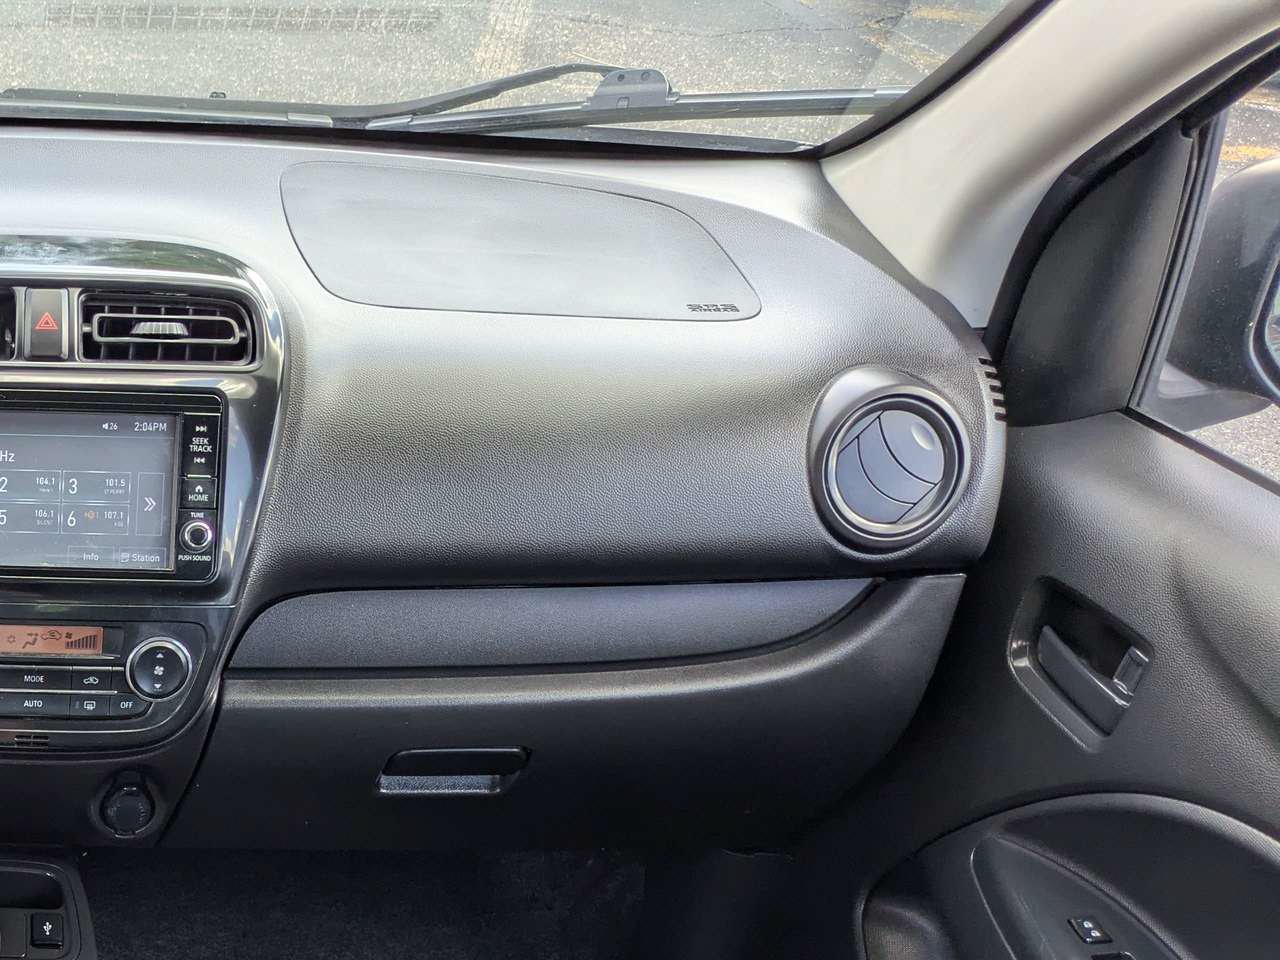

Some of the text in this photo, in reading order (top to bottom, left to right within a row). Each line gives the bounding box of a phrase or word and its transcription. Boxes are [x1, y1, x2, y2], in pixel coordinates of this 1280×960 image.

[134, 422, 167, 432] 2:04PM
[192, 437, 209, 445] SEEK
[189, 445, 212, 453] TRACK
[0, 476, 8, 493] 2
[68, 478, 78, 494] 3
[67, 511, 76, 527] 6
[83, 552, 99, 561] Info
[131, 553, 160, 562] Station
[24, 675, 44, 683] MODE
[23, 700, 43, 708] AUTO
[120, 701, 133, 709] OFF
